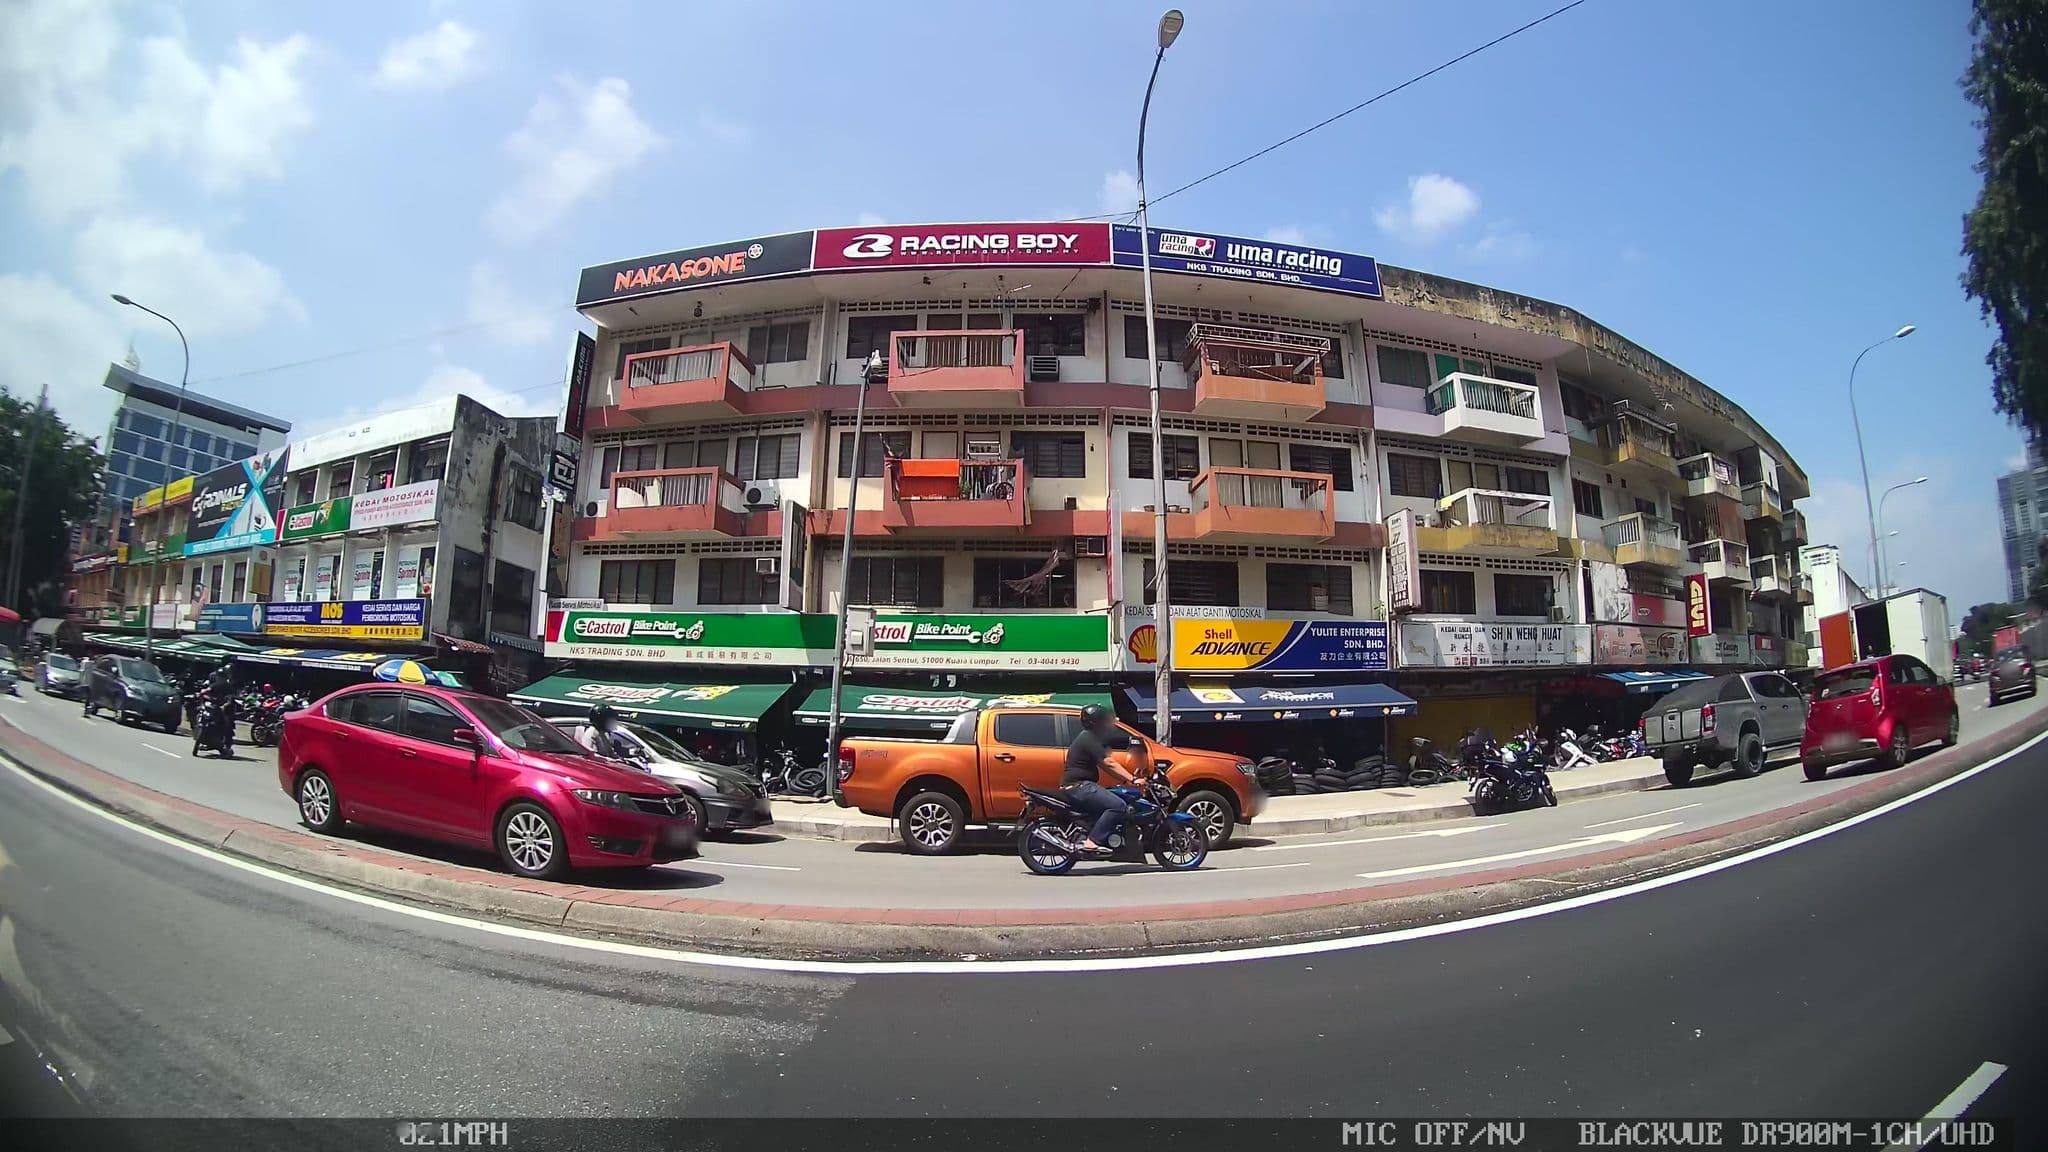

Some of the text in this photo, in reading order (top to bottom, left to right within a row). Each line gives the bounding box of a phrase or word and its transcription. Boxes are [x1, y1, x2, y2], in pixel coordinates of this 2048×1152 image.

[900, 234, 1078, 250] RACING BOY
[1161, 234, 1187, 244] uma
[1160, 242, 1194, 254] racing
[1227, 242, 1342, 276] uma racing
[613, 252, 746, 291] NAKASONE
[1211, 264, 1252, 277] TRADING
[354, 498, 380, 508] KEDAI
[383, 489, 435, 503] MOTOSIKAL
[1689, 580, 1705, 628] GIVI
[1125, 607, 1143, 617] KEDAI
[1186, 608, 1201, 617] ALAT
[586, 619, 626, 636] Castrol
[633, 620, 677, 632] Bike Point
[874, 624, 971, 640] strol Bike Point
[1311, 628, 1385, 637] YULITE ENTERPRISE
[1204, 629, 1232, 640] Shell
[1491, 627, 1513, 640] SHN
[1541, 627, 1562, 641] HUAT
[1190, 641, 1272, 656] ADVANCE
[1344, 639, 1386, 648] SDN. BHD.
[569, 647, 666, 658] NKS TRADING SDN. BHD
[1028, 658, 1059, 666] 03-4041
[1060, 658, 1080, 666] 9430
